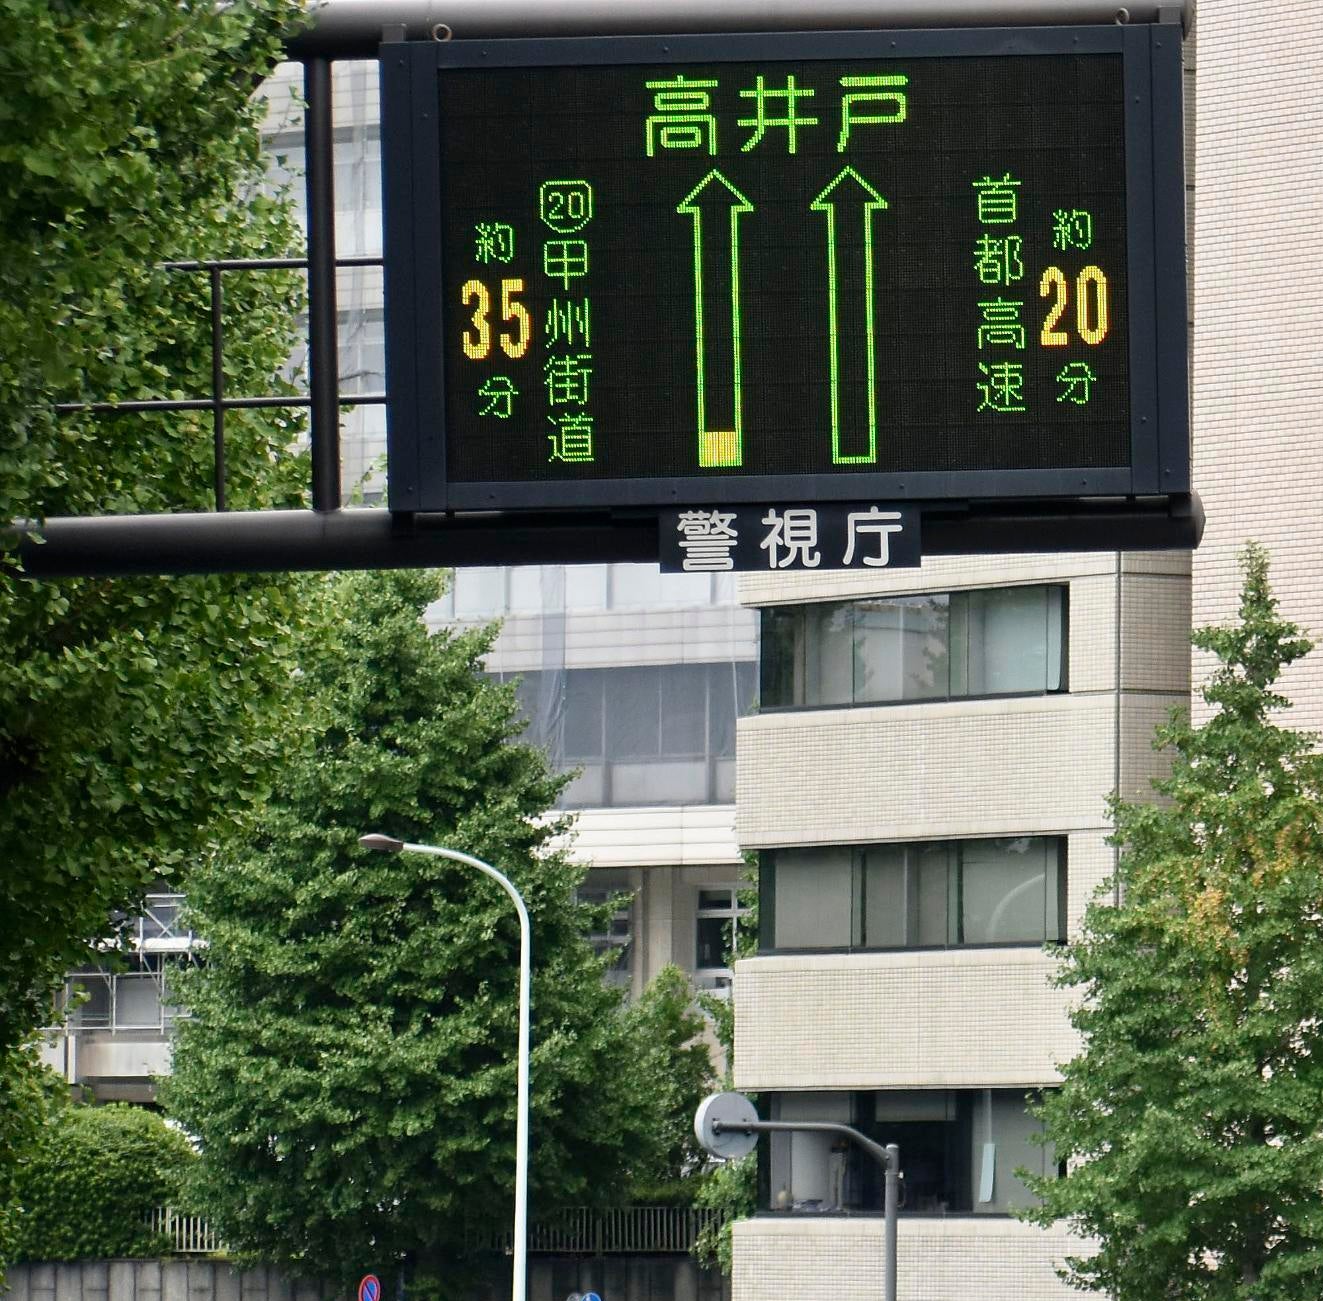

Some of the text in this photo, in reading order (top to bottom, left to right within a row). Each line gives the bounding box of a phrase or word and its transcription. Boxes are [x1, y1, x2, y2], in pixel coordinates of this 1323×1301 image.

[646, 75, 908, 157] 高井戸
[543, 240, 594, 462] 甲州街道
[971, 173, 1026, 413] 首都高速
[677, 506, 905, 571] 警視庁
